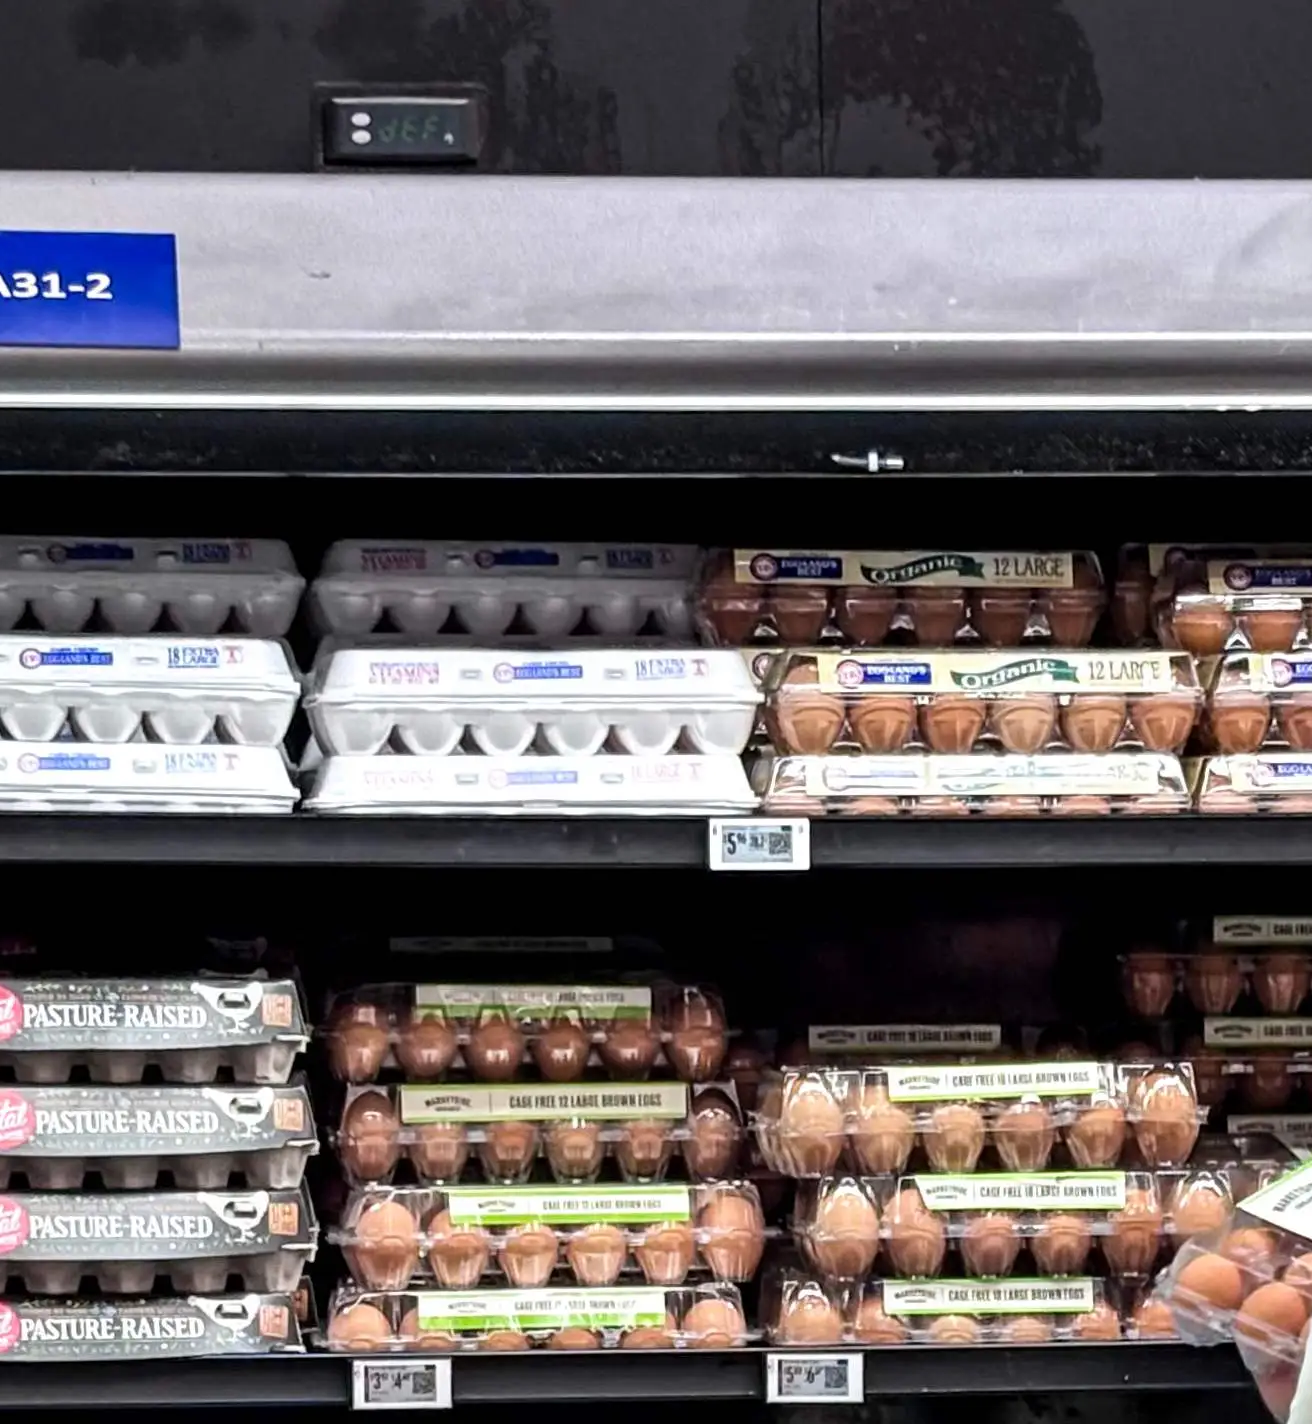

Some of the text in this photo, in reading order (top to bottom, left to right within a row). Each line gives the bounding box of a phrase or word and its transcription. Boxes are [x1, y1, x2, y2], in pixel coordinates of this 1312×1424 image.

[871, 556, 1064, 582] Organic 12 LARGE
[961, 660, 1055, 688] Organic
[1090, 663, 1105, 679] 12
[23, 1005, 206, 1029] PASTURE-RAISED
[35, 1110, 218, 1134] PASTURE-RAISED
[28, 1216, 213, 1240] PASTURE-RAISED
[21, 1317, 204, 1341] PASTURE-RAISED
